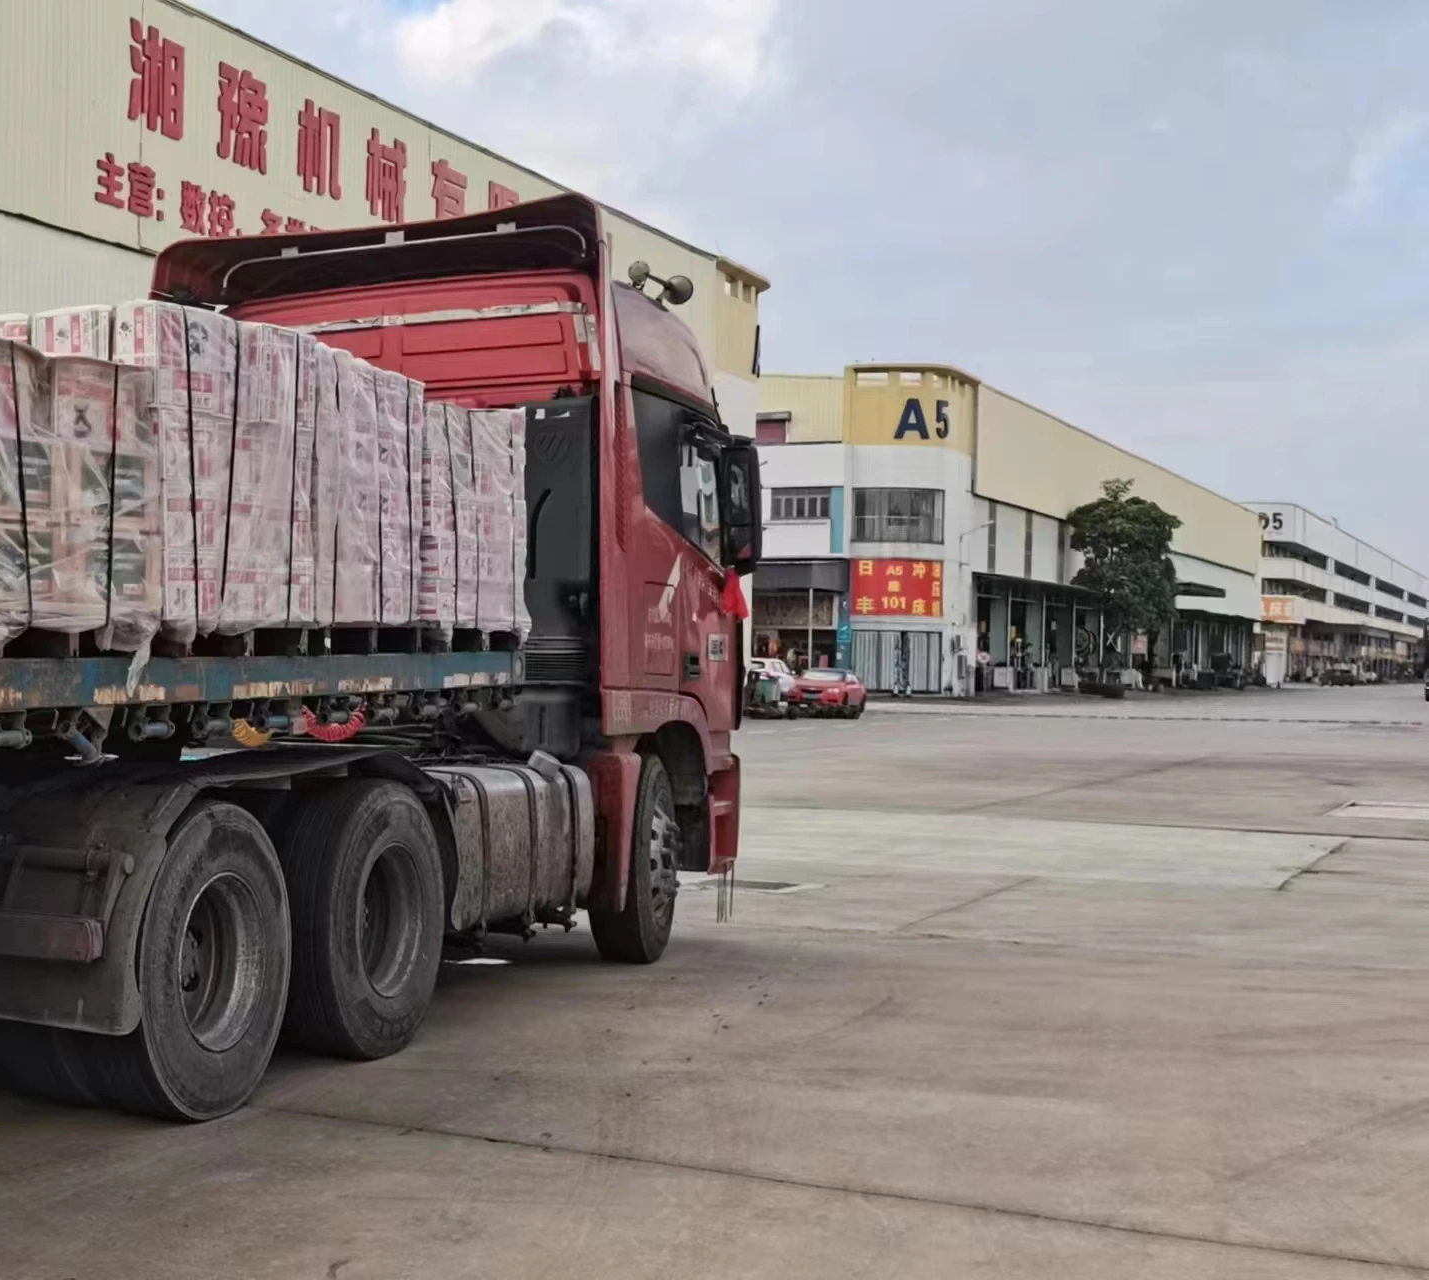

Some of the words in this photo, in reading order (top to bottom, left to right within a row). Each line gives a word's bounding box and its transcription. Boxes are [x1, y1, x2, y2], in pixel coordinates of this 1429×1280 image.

[894, 398, 949, 439] A5
[886, 565, 904, 576] A5
[881, 597, 906, 609] 101
